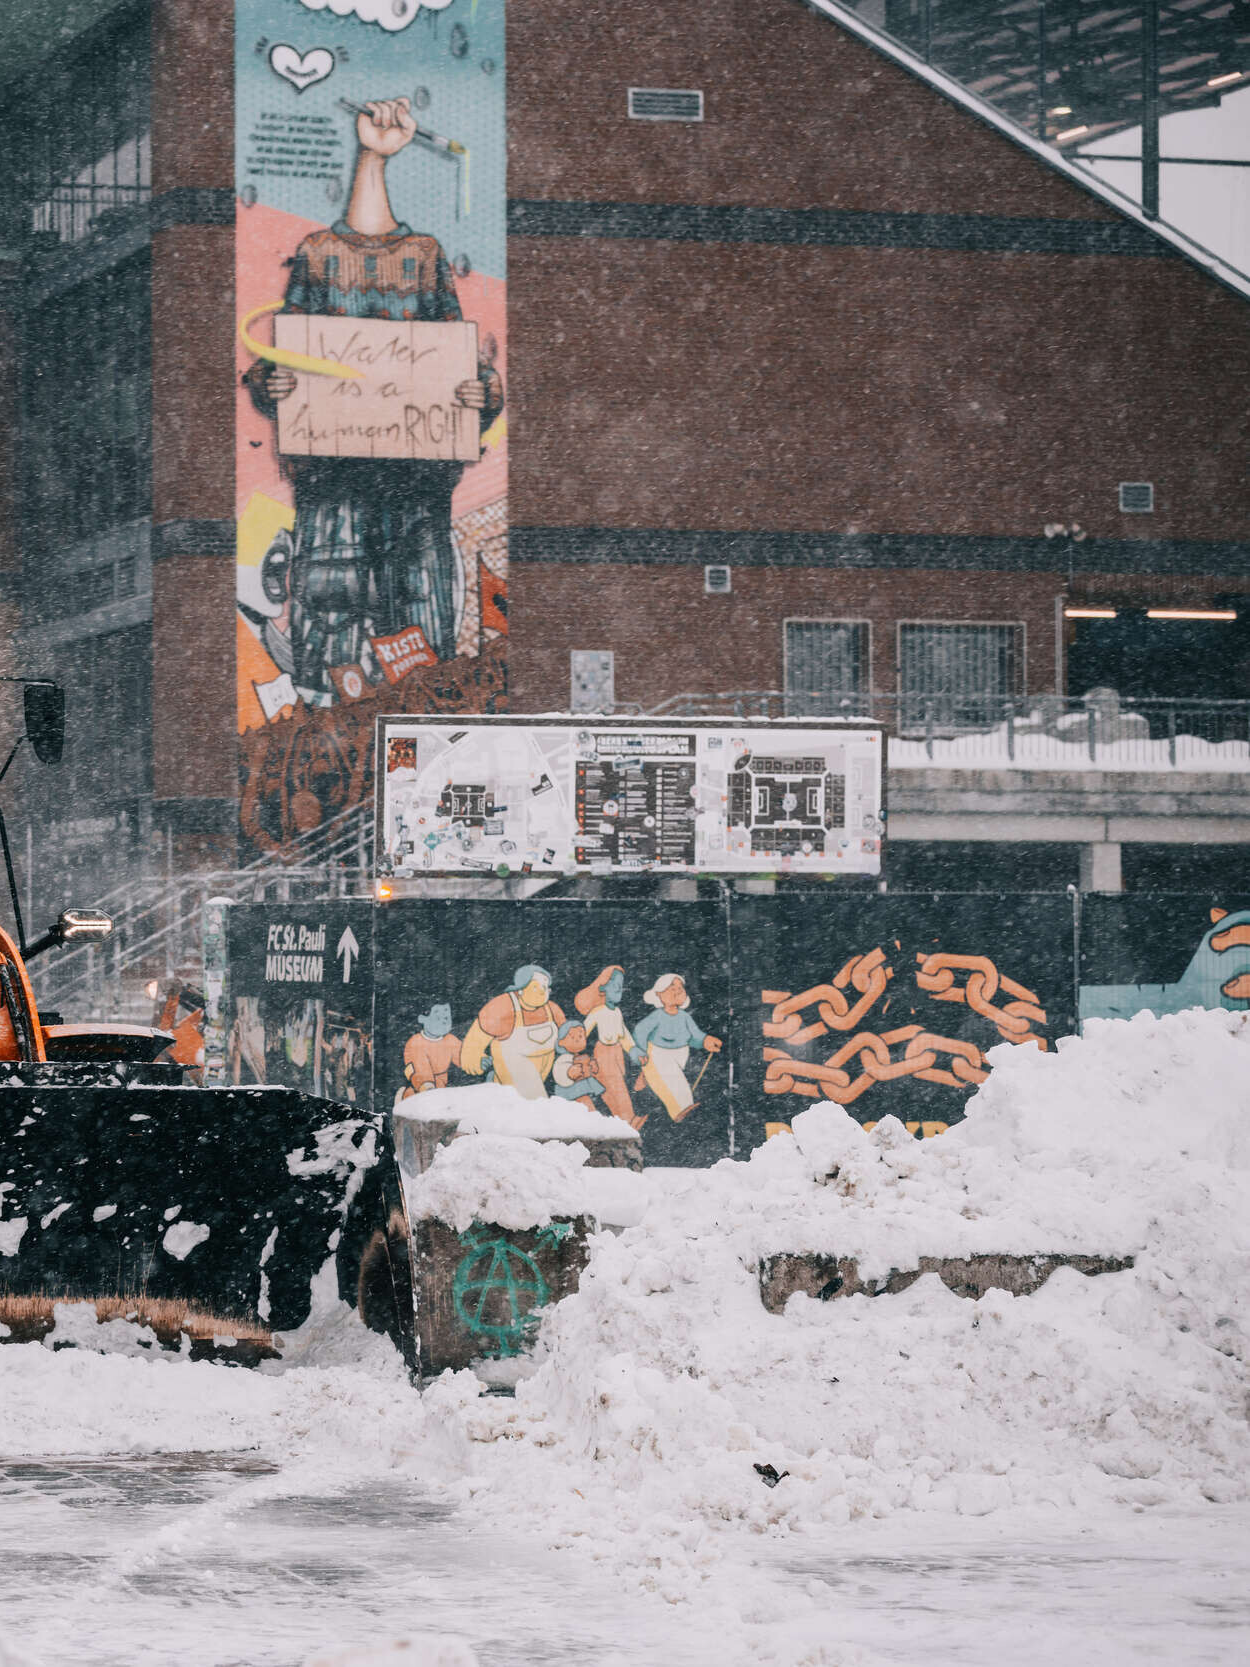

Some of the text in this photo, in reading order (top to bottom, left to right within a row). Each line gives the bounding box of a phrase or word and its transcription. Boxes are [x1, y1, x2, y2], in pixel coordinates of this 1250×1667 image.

[319, 330, 438, 365] Water
[332, 380, 405, 399] is a
[287, 402, 400, 441] human
[266, 923, 327, 952] FC St. Pauli
[265, 954, 324, 983] MUSEUM
